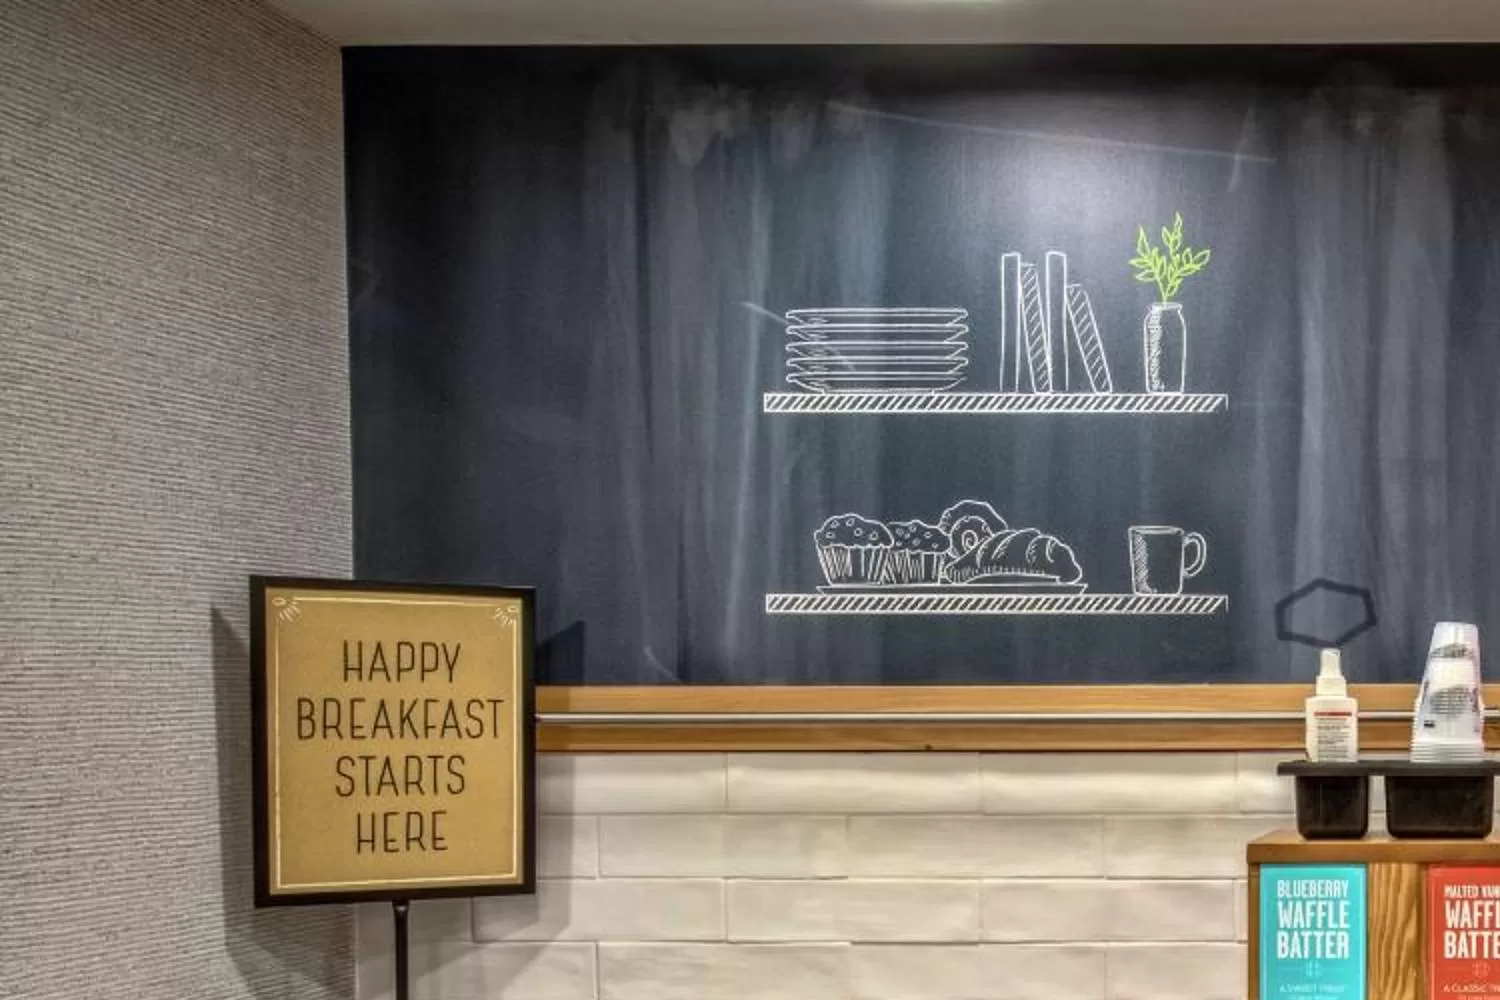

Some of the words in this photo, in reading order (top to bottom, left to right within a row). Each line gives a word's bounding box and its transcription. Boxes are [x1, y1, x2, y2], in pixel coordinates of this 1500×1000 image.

[343, 640, 461, 684] HAPPY
[297, 697, 504, 740] BREAKFAST
[335, 755, 466, 797] STARTS
[356, 809, 449, 854] HERE
[1277, 879, 1349, 898] BLUEBERRY
[1278, 901, 1351, 929] WAFFLE
[1277, 931, 1350, 959] BATTER
